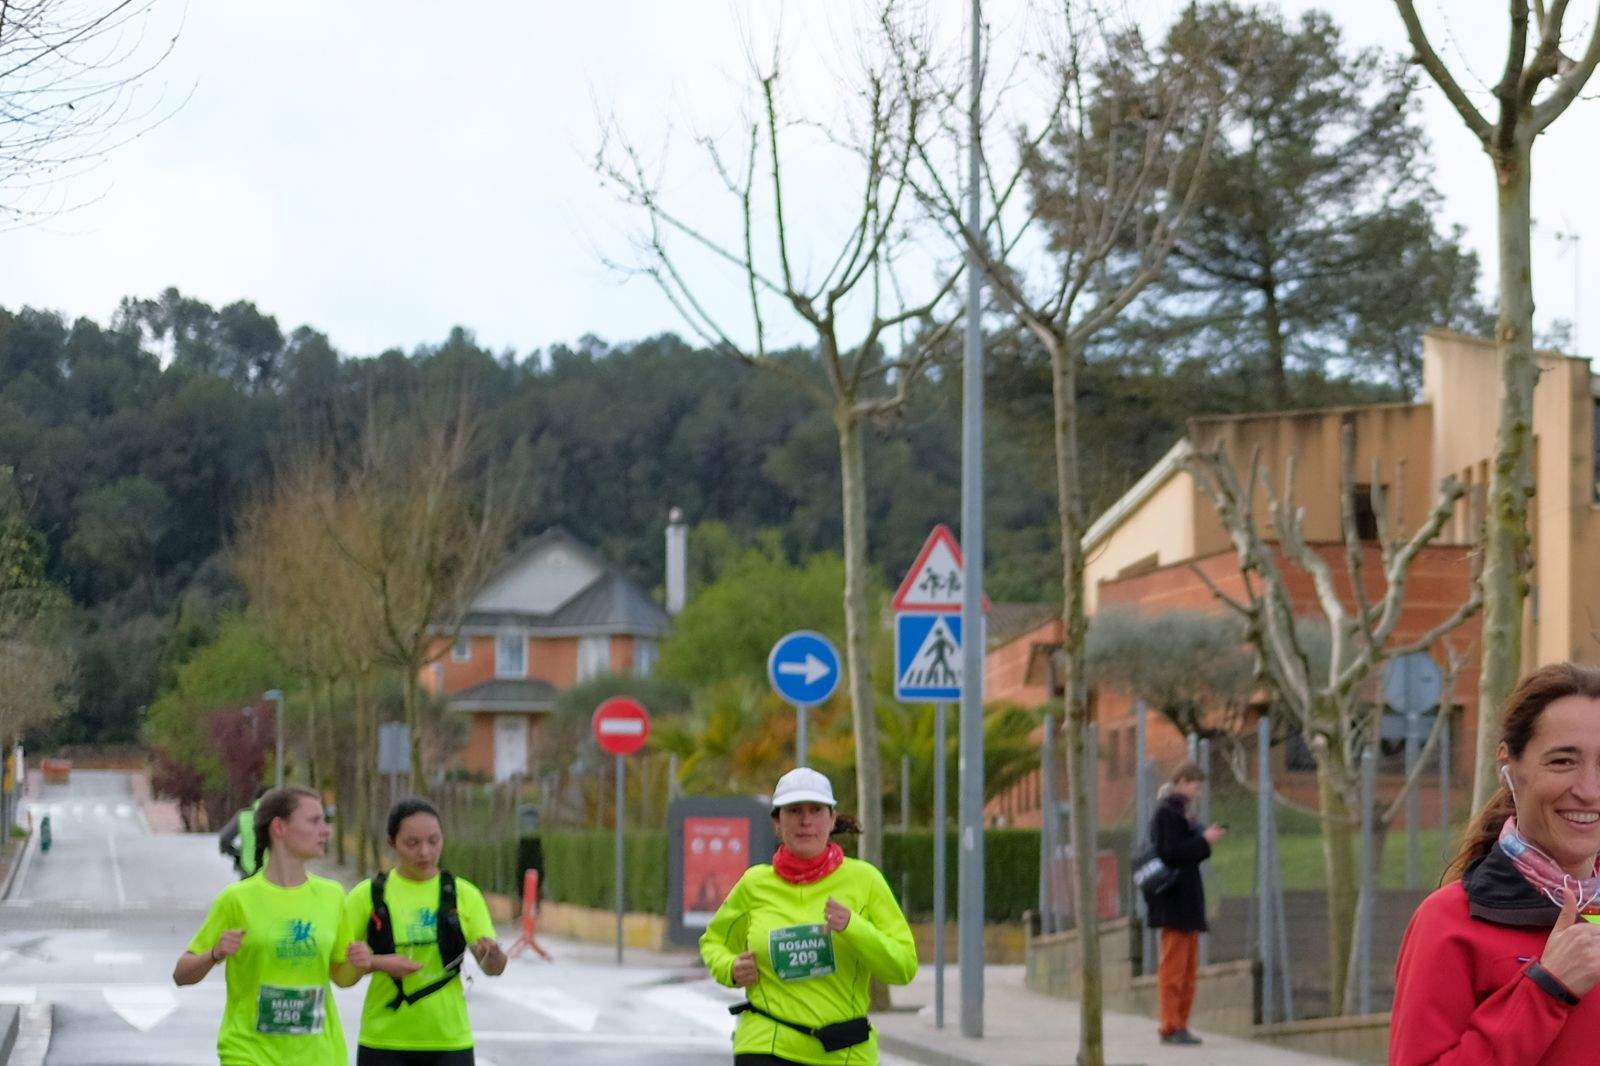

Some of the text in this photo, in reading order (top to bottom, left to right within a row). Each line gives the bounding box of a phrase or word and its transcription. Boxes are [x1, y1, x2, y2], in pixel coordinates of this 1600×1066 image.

[778, 939, 826, 952] ROSANA
[789, 951, 817, 967] 209
[273, 1010, 300, 1024] 250
